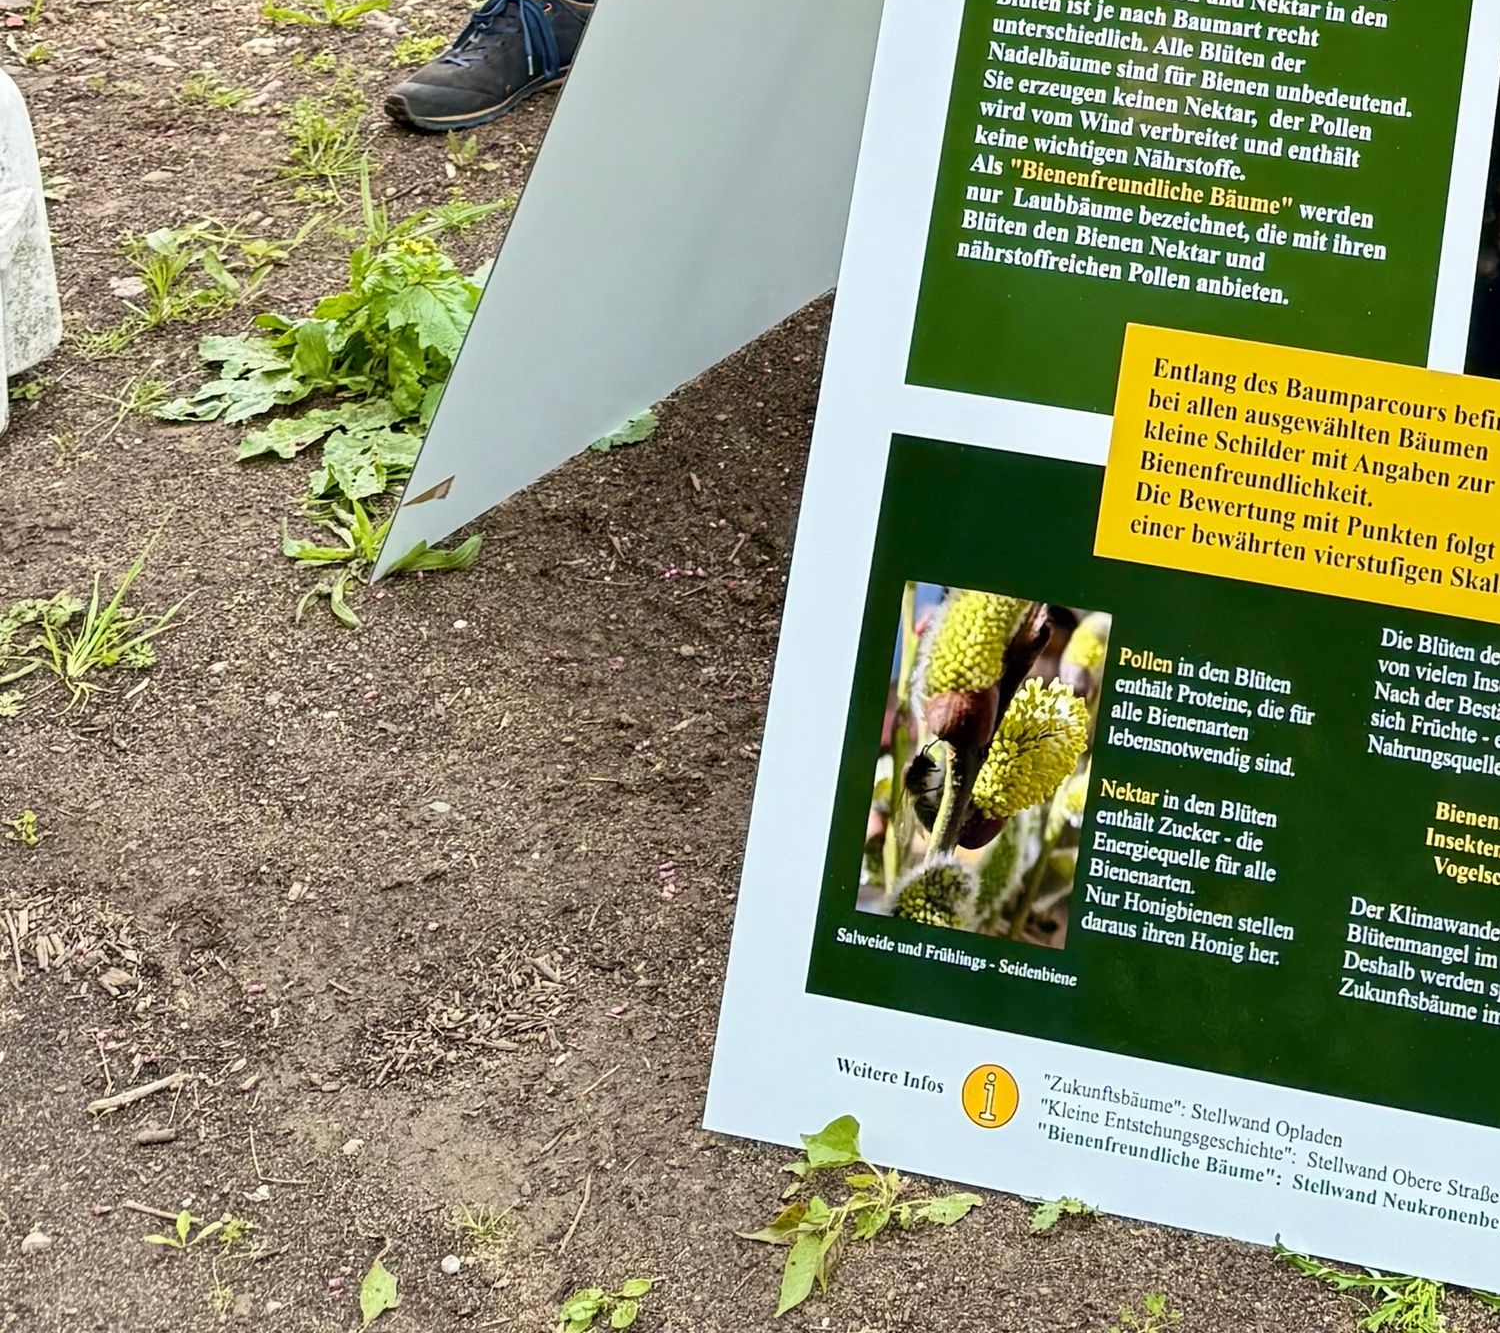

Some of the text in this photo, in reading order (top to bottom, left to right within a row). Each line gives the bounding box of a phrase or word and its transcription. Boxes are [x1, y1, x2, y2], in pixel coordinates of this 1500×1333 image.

[1325, 0, 1345, 22] in
[1351, 5, 1388, 28] den
[1153, 357, 1237, 394] Entlang
[1243, 372, 1278, 396] des
[1286, 378, 1447, 422] Baumparcours
[1149, 388, 1488, 462] bei allen ausgewählten Bäumen
[1140, 450, 1373, 508] Bienenfreundlichkeit.
[1144, 419, 1496, 494] kleine Schilder mit Angaben zur
[1135, 481, 1495, 564] Die Bewertung mit Punkten folgt
[1130, 514, 1186, 540] einer
[1191, 522, 1305, 561] bewährten
[1314, 544, 1443, 585] vierstufigen
[1119, 646, 1291, 695] Pollen in den Blüten
[1380, 627, 1413, 651] Die
[1417, 634, 1475, 662] Blüten
[1377, 659, 1410, 678] von
[1415, 662, 1467, 688] vielen
[1115, 677, 1316, 726] enthält Proteine, die für
[1107, 725, 1295, 778] lebensnotwendig sind.
[1099, 778, 1277, 828] Nektar in den Blüten
[1092, 830, 1277, 882] Energiequelle für alle
[1095, 808, 1155, 833] enthält
[1157, 816, 1221, 844] Zucker
[1235, 830, 1264, 852] die
[1089, 857, 1195, 895] Bienenarten.
[1349, 896, 1385, 920] Der
[836, 927, 895, 952] Salweide
[897, 942, 923, 957] und
[925, 944, 987, 972] Frühlings
[998, 958, 1078, 987] Seidenbiene
[1346, 922, 1469, 966] Blütenmangel
[1474, 946, 1498, 969] im
[837, 1057, 944, 1094] Weitere Infos
[1044, 1073, 1343, 1148] "Zukunftsbäume": Stellwand Opladen
[1038, 1122, 1201, 1170] "Bienenfreundliche
[1205, 1156, 1282, 1186] Bäume":
[1292, 1174, 1377, 1206] Stellwand
[1041, 1098, 1499, 1204] "Kleine Entstehungsgeschichte": Stellwand Obere Straße
